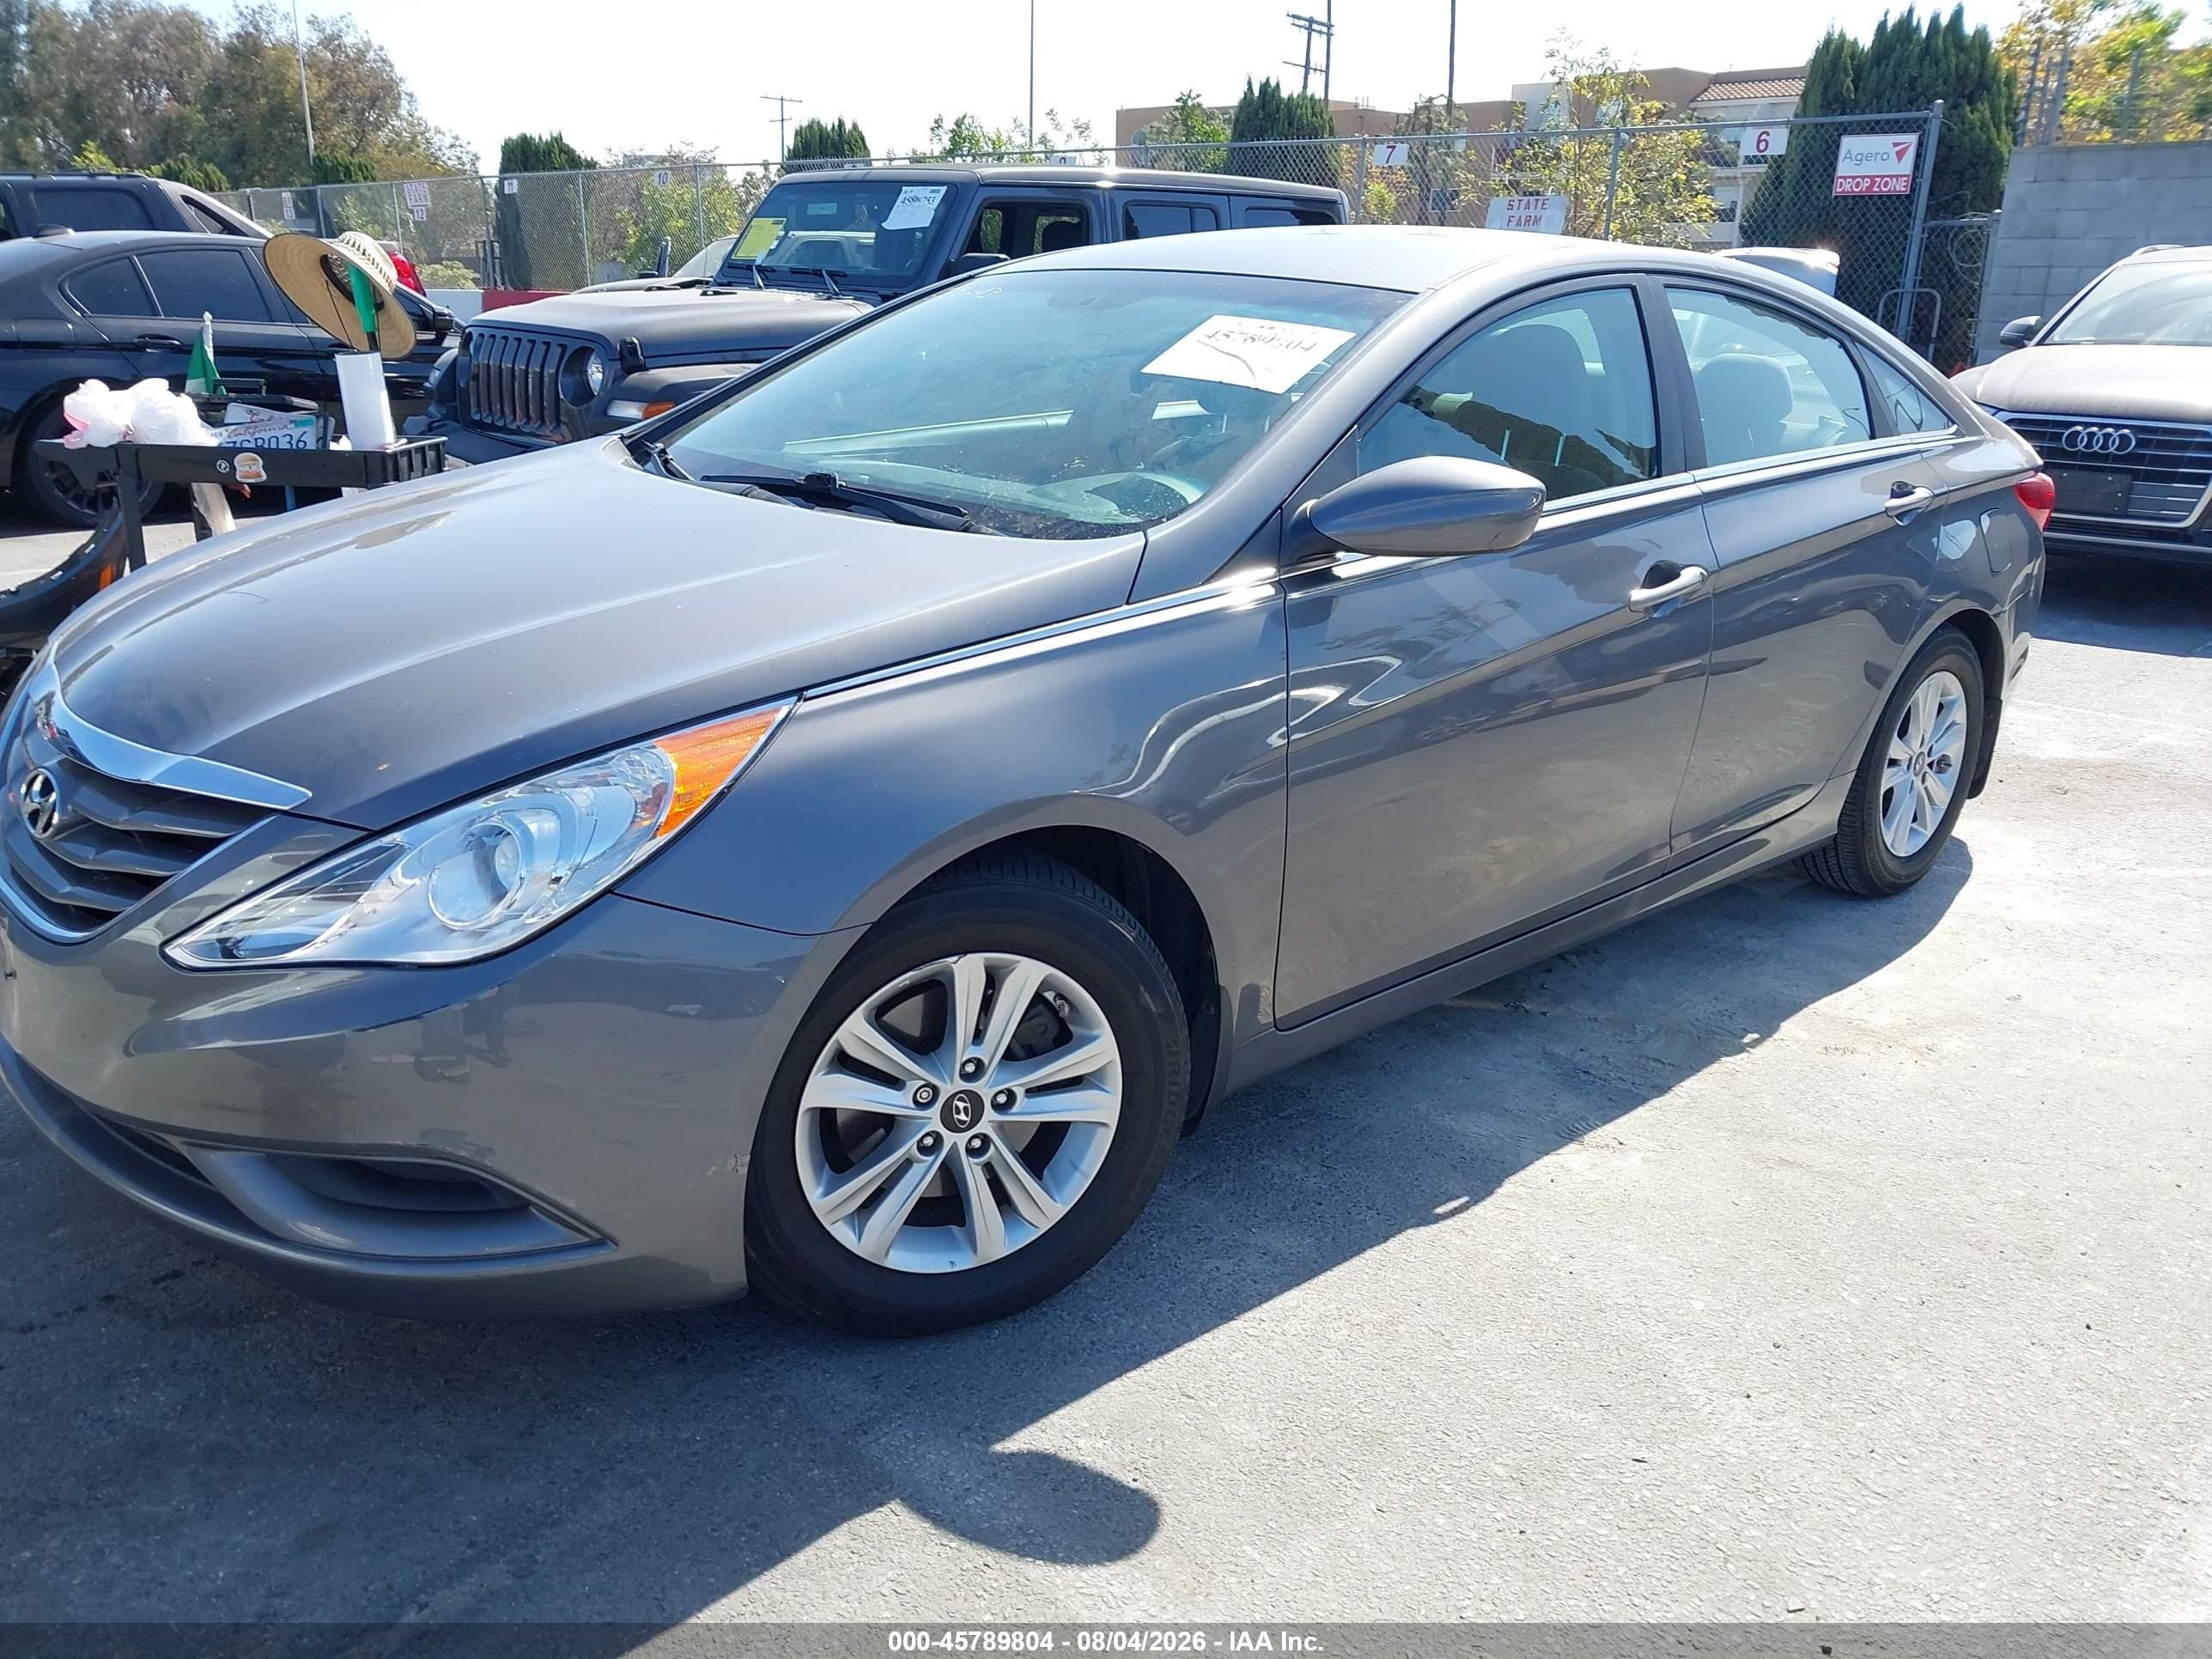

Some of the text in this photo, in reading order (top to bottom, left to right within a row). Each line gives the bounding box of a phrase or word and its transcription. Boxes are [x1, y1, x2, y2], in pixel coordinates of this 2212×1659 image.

[1756, 131, 1771, 154] 6
[1386, 145, 1397, 164] 7
[1843, 149, 1890, 166] Agero
[658, 172, 668, 185] 10
[1836, 177, 1908, 192] DROP ZONE
[1506, 198, 1549, 211] STATE
[1506, 215, 1541, 228] FARM
